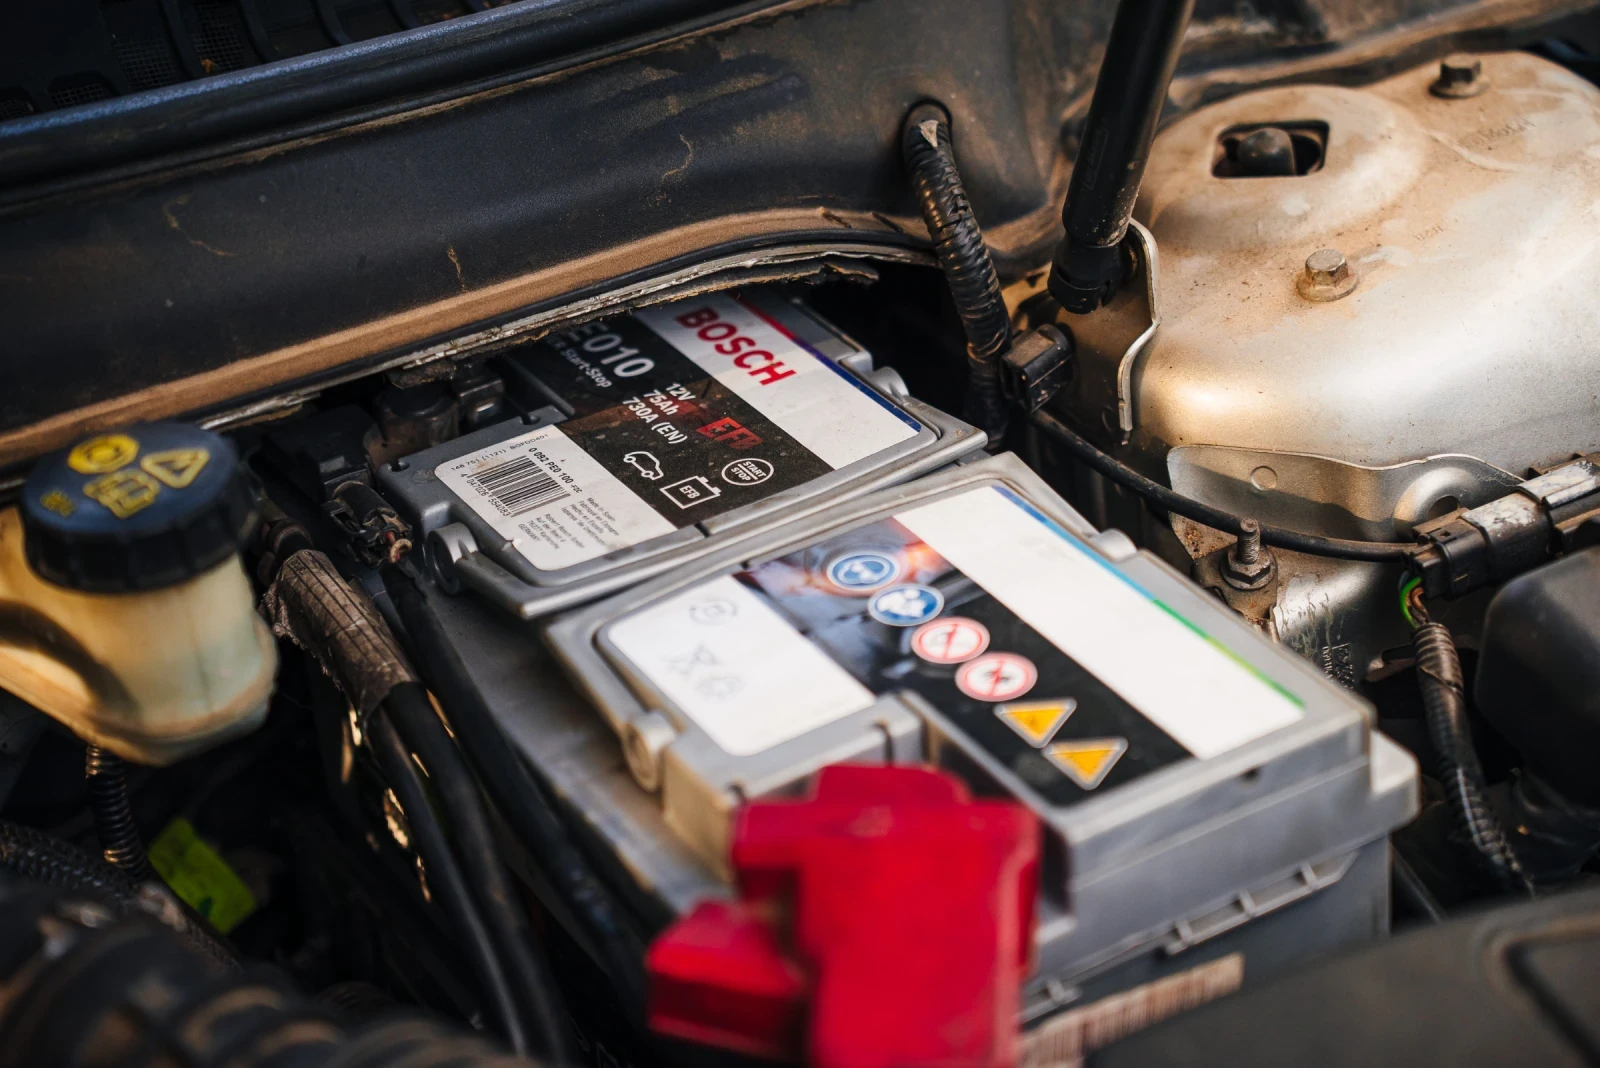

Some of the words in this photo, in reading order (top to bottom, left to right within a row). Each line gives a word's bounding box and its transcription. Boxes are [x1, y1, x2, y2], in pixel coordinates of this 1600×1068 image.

[675, 307, 797, 386] BOSCH
[643, 389, 679, 415] 75Ah
[666, 382, 696, 401] 12V
[622, 396, 659, 423] 730A
[651, 422, 688, 444] (EN)
[533, 451, 550, 463] 092
[558, 472, 574, 484] 100
[731, 467, 751, 481] STOP
[742, 461, 767, 477] START
[679, 485, 700, 498] EFB
